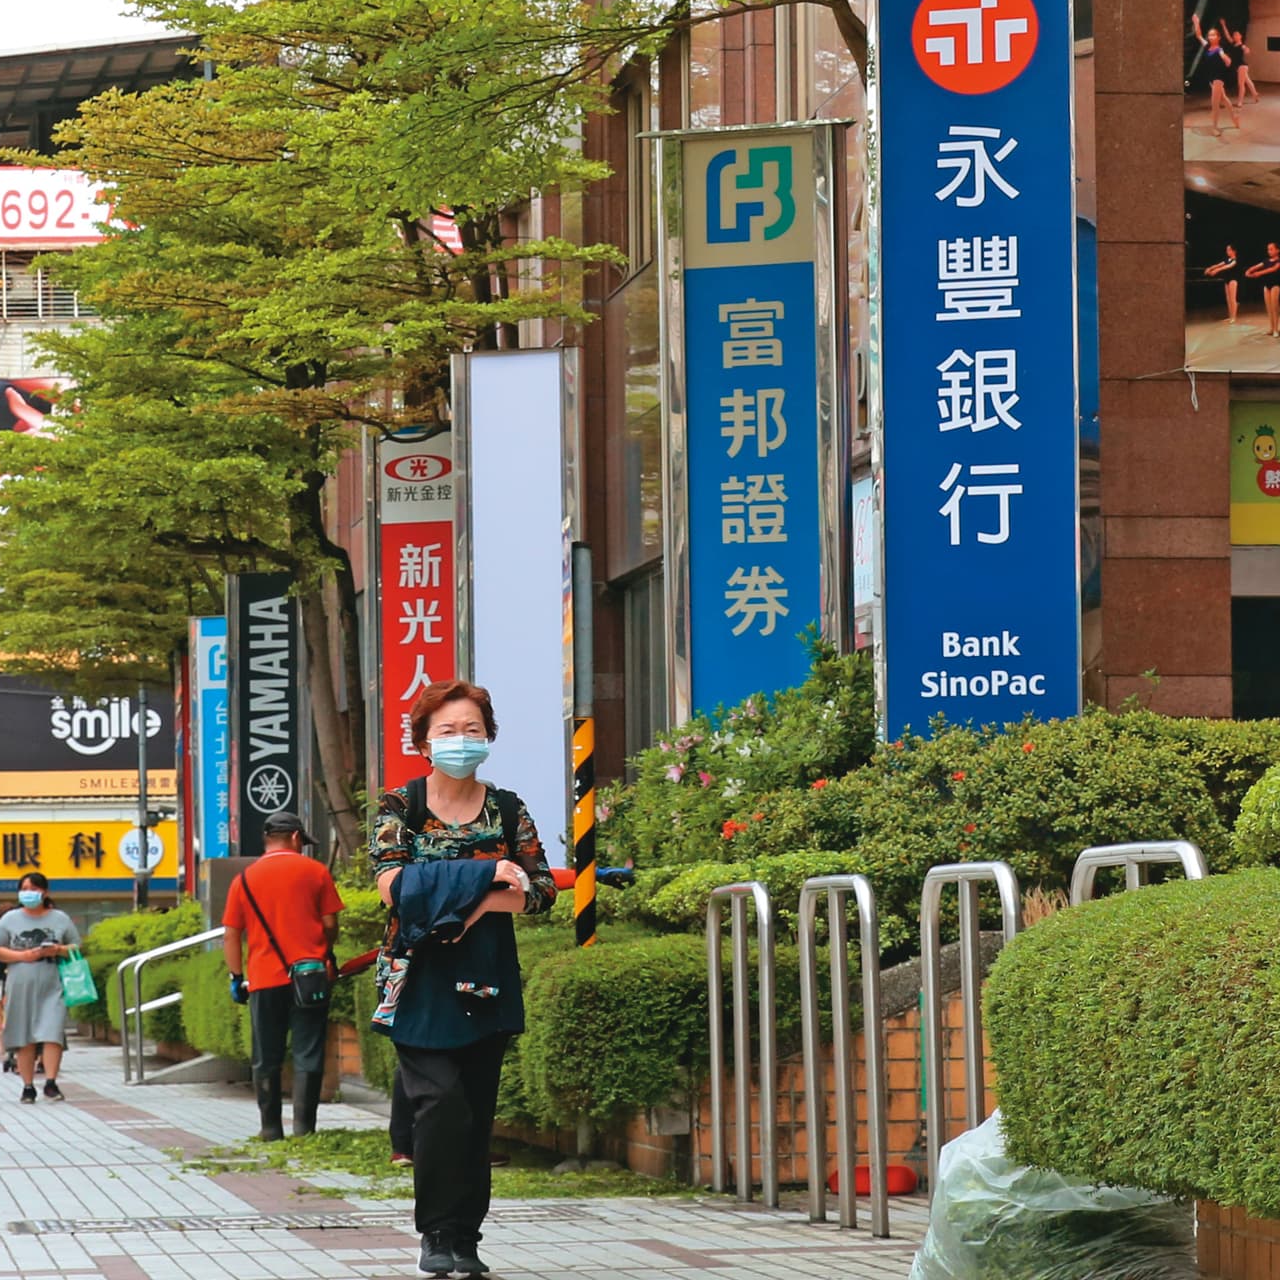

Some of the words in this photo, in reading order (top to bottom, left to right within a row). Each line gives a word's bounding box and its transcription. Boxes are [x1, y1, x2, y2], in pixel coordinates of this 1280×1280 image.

[934, 126, 1023, 546] 永豐銀行
[718, 298, 790, 637] 富邦證券
[387, 485, 452, 502] 新光金控
[942, 630, 1021, 659] Bank
[249, 596, 290, 761] YAMAHA
[920, 669, 1046, 698] SinoPac
[50, 696, 162, 740] smile
